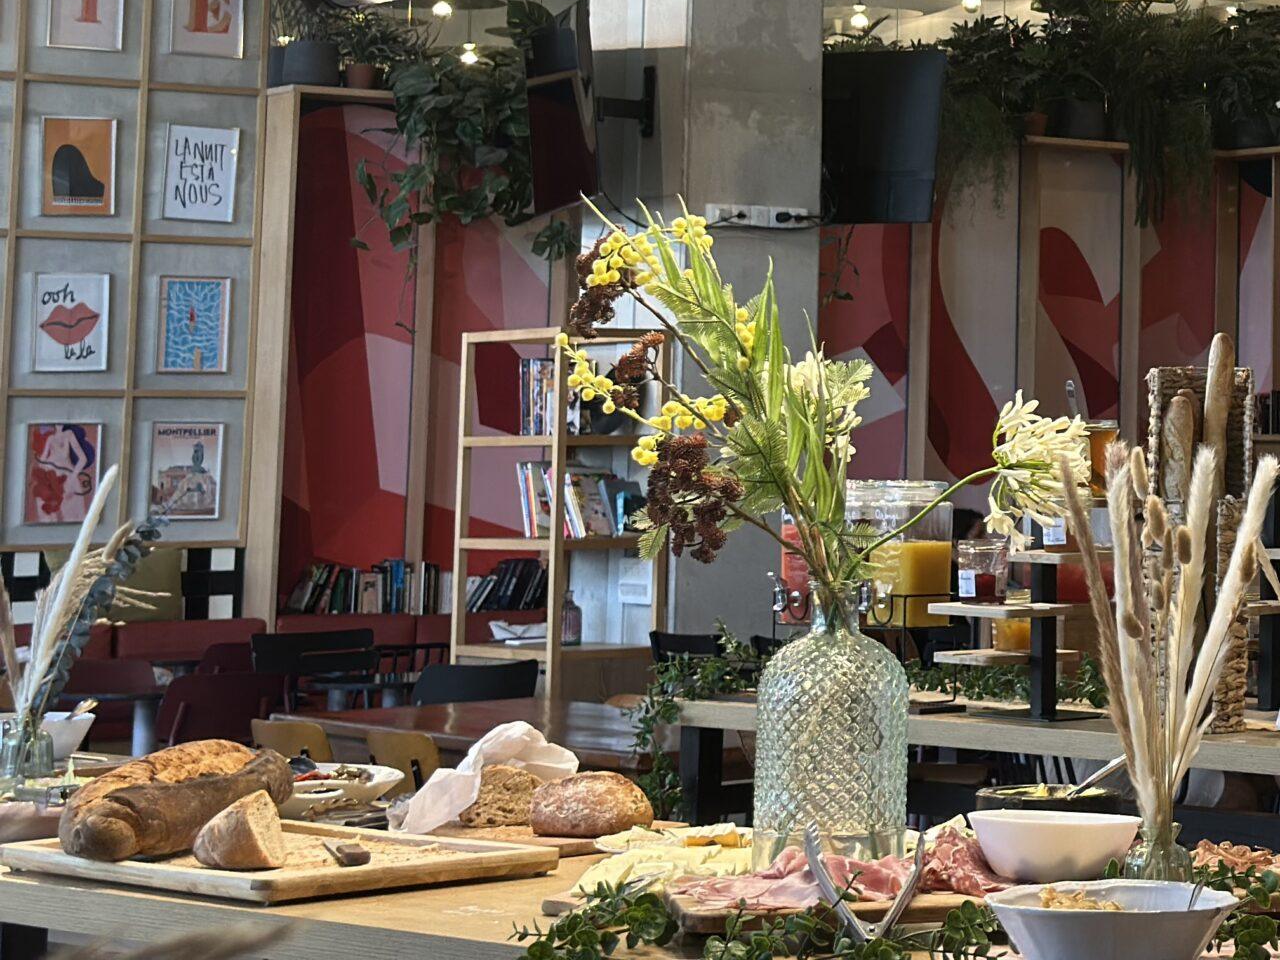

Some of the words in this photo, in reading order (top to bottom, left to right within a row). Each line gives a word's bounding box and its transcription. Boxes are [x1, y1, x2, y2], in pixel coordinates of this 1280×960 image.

[174, 179, 223, 209] NOUS
[41, 282, 75, 305] ooh
[158, 428, 217, 437] MONTPELLIER
